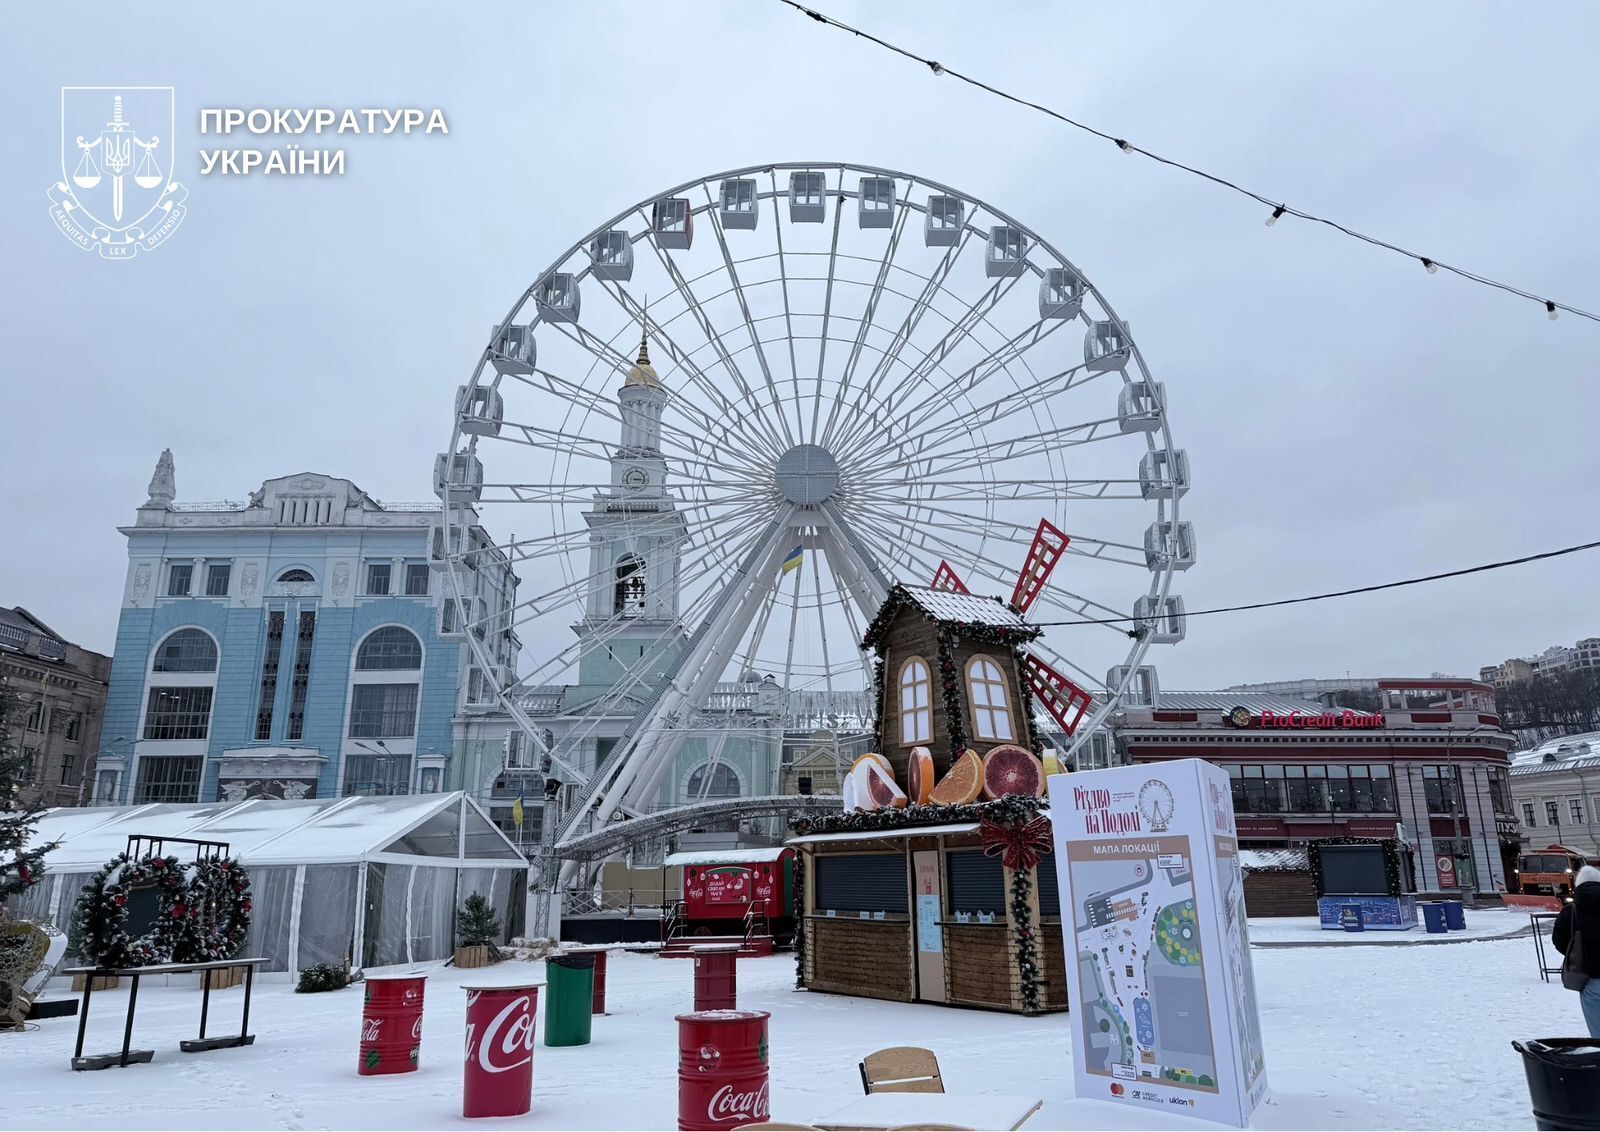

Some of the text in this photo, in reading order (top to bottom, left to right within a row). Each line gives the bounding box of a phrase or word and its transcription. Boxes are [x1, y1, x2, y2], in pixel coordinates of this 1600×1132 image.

[1260, 710, 1385, 727] ProCredit Bank
[1073, 785, 1111, 814] Різдво
[1085, 805, 1141, 836] на Подолі
[1093, 840, 1161, 855] МАПА ЛОКАЦІЇ
